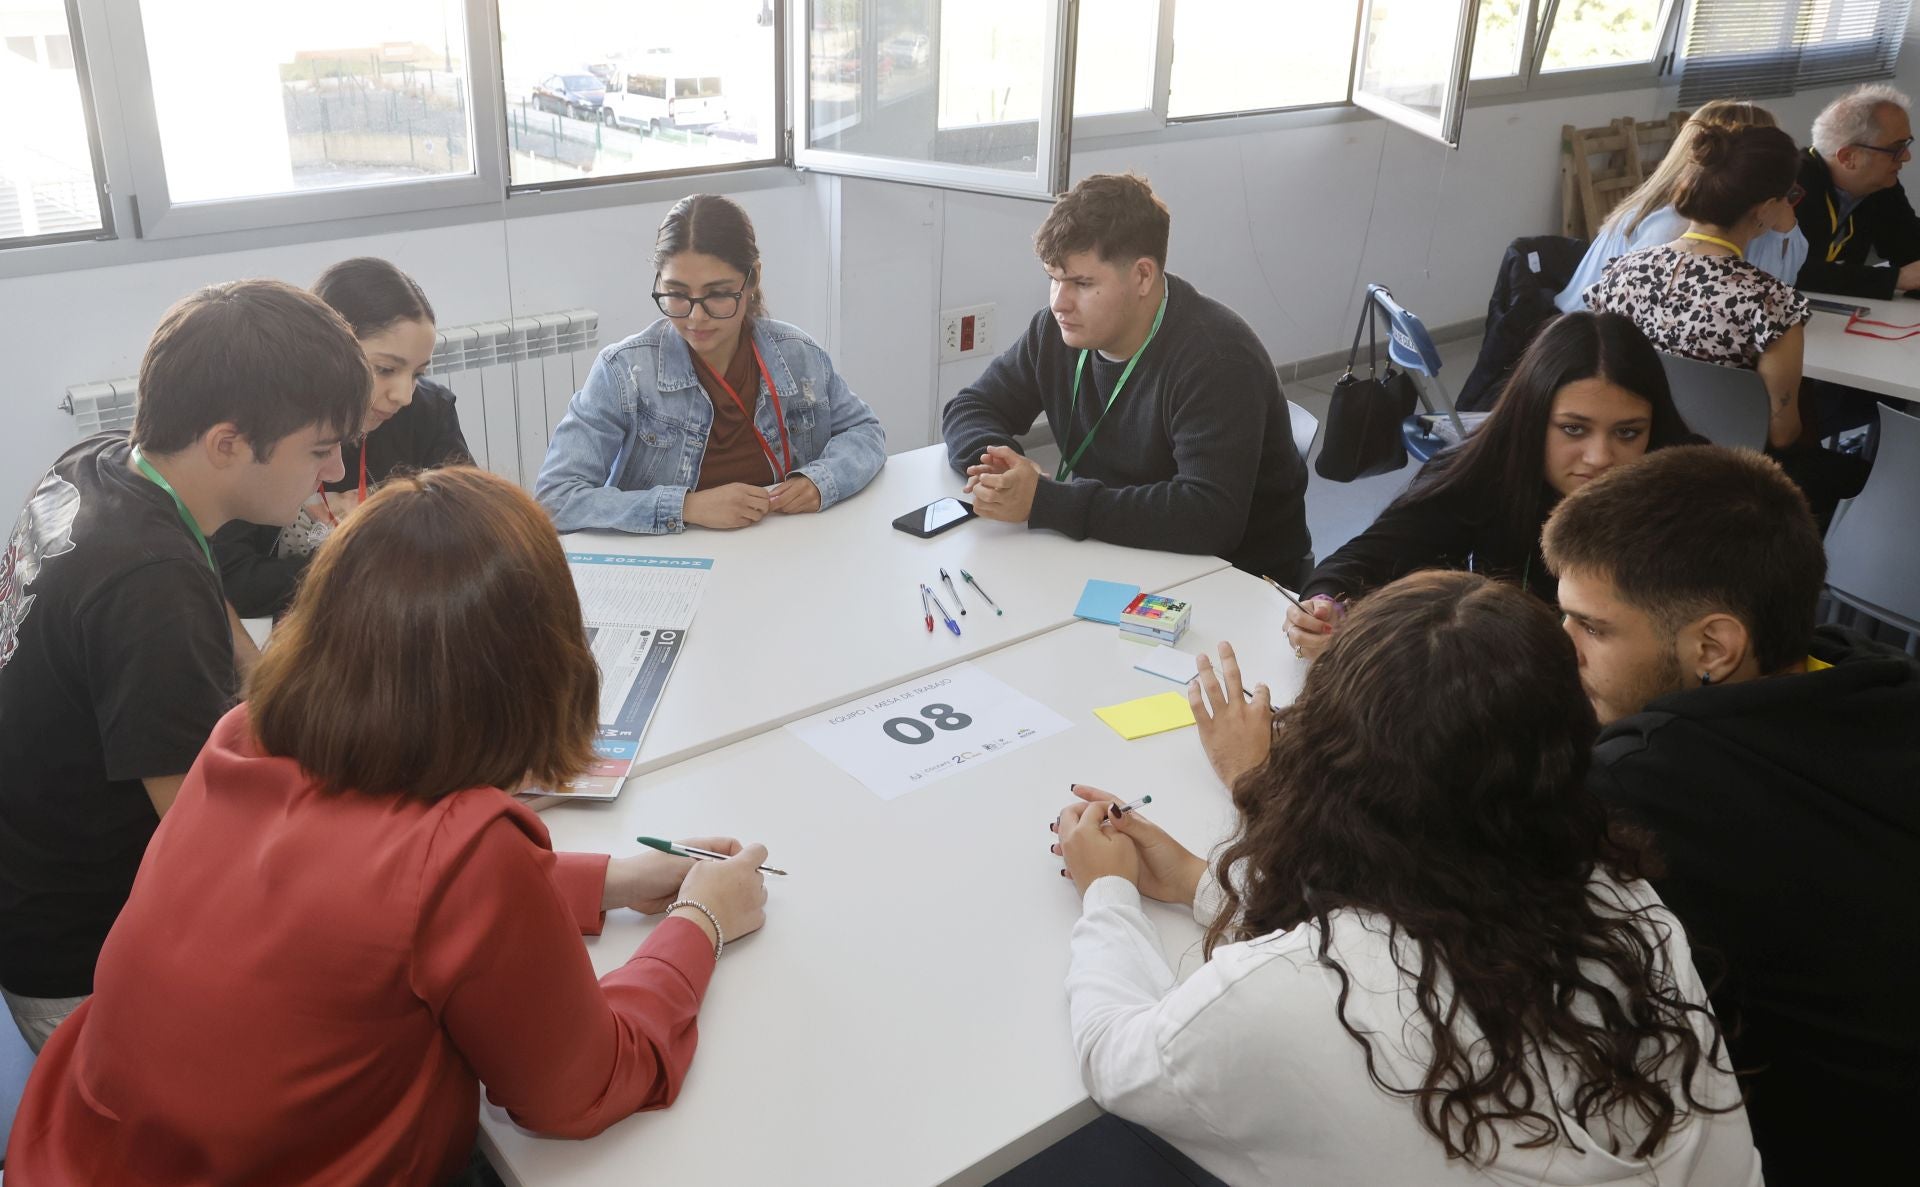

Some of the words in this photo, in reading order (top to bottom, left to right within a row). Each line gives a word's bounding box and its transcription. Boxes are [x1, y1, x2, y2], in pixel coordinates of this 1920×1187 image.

[604, 557, 702, 566] HACKATHON
[658, 631, 677, 645] 01
[829, 709, 866, 725] EQUIPO
[875, 697, 901, 710] MESA
[900, 691, 915, 700] DE
[914, 679, 952, 695] TRABAJO
[882, 703, 973, 745] 08
